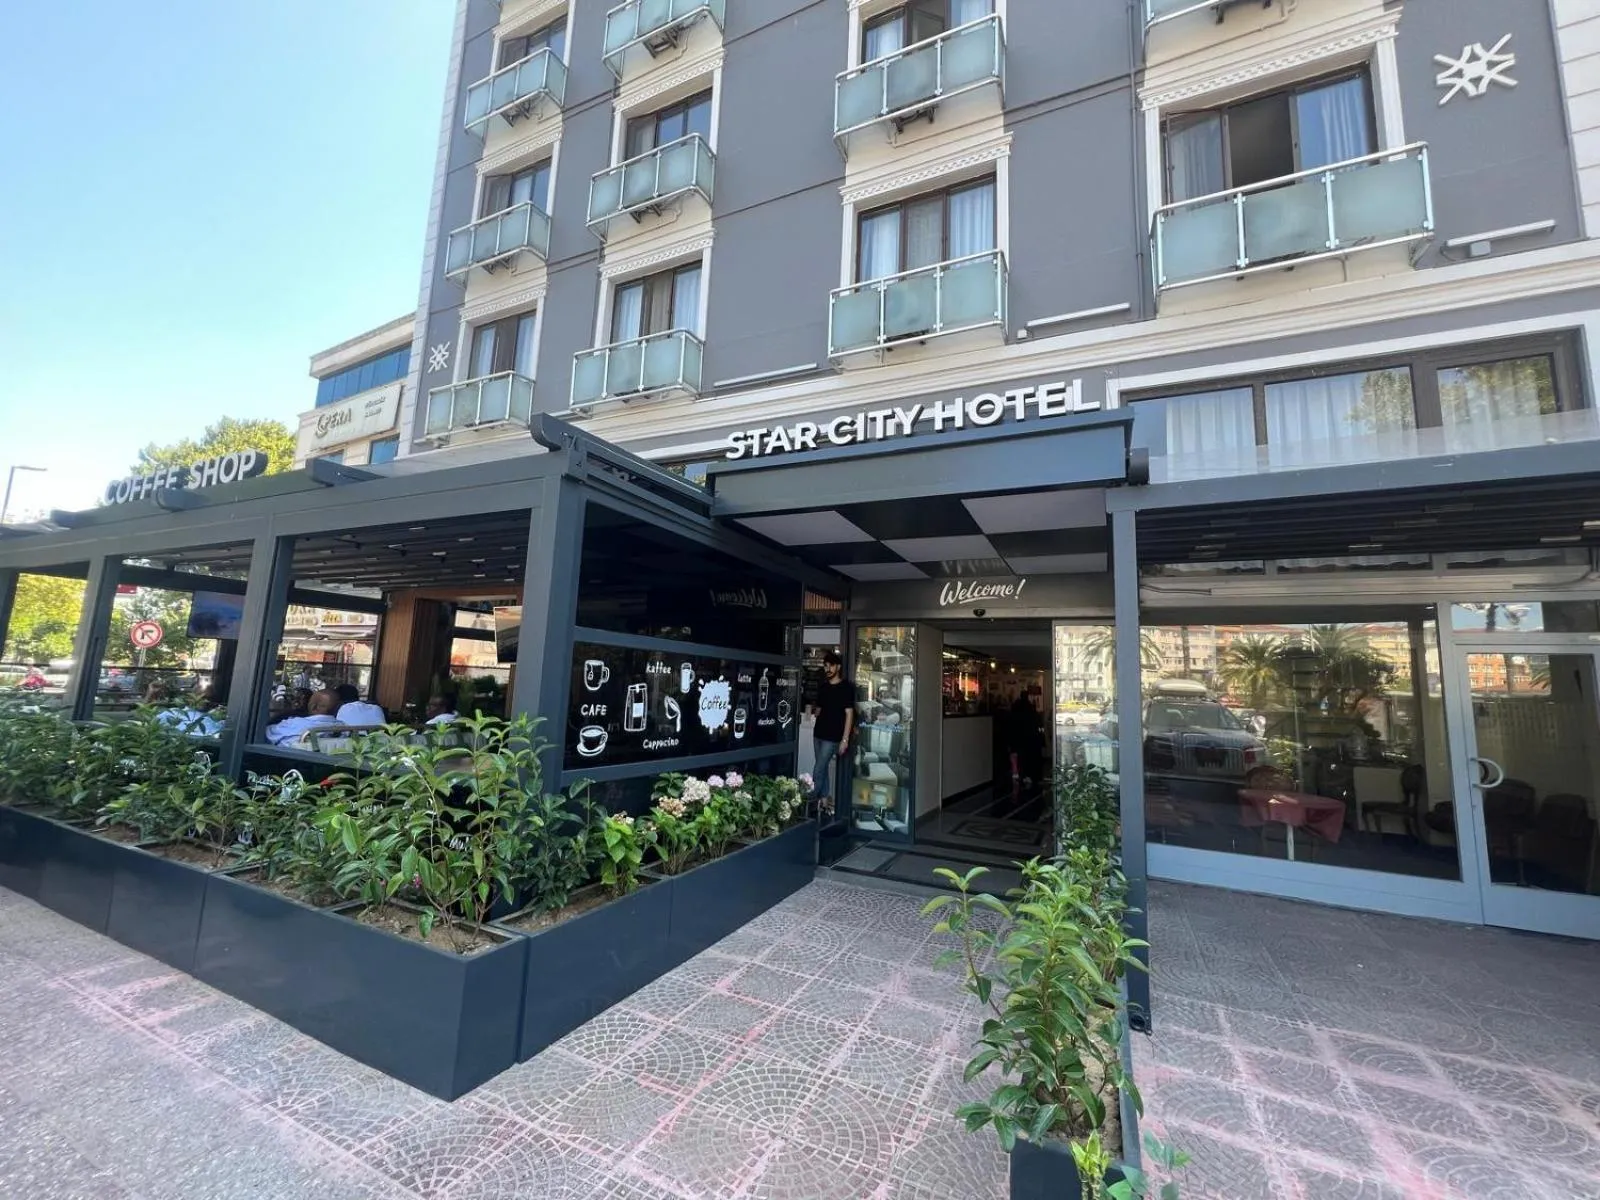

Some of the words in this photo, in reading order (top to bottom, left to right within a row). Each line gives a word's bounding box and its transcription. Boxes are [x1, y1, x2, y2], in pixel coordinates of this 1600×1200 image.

[726, 421, 819, 459] STAR
[828, 404, 922, 444] CITY
[934, 379, 1100, 430] HOTEL
[103, 465, 180, 506] COFFEE
[188, 448, 257, 489] SHOP
[939, 579, 1027, 607] Welcome!
[581, 704, 607, 716] CAFE
[701, 695, 728, 711] Coffee
